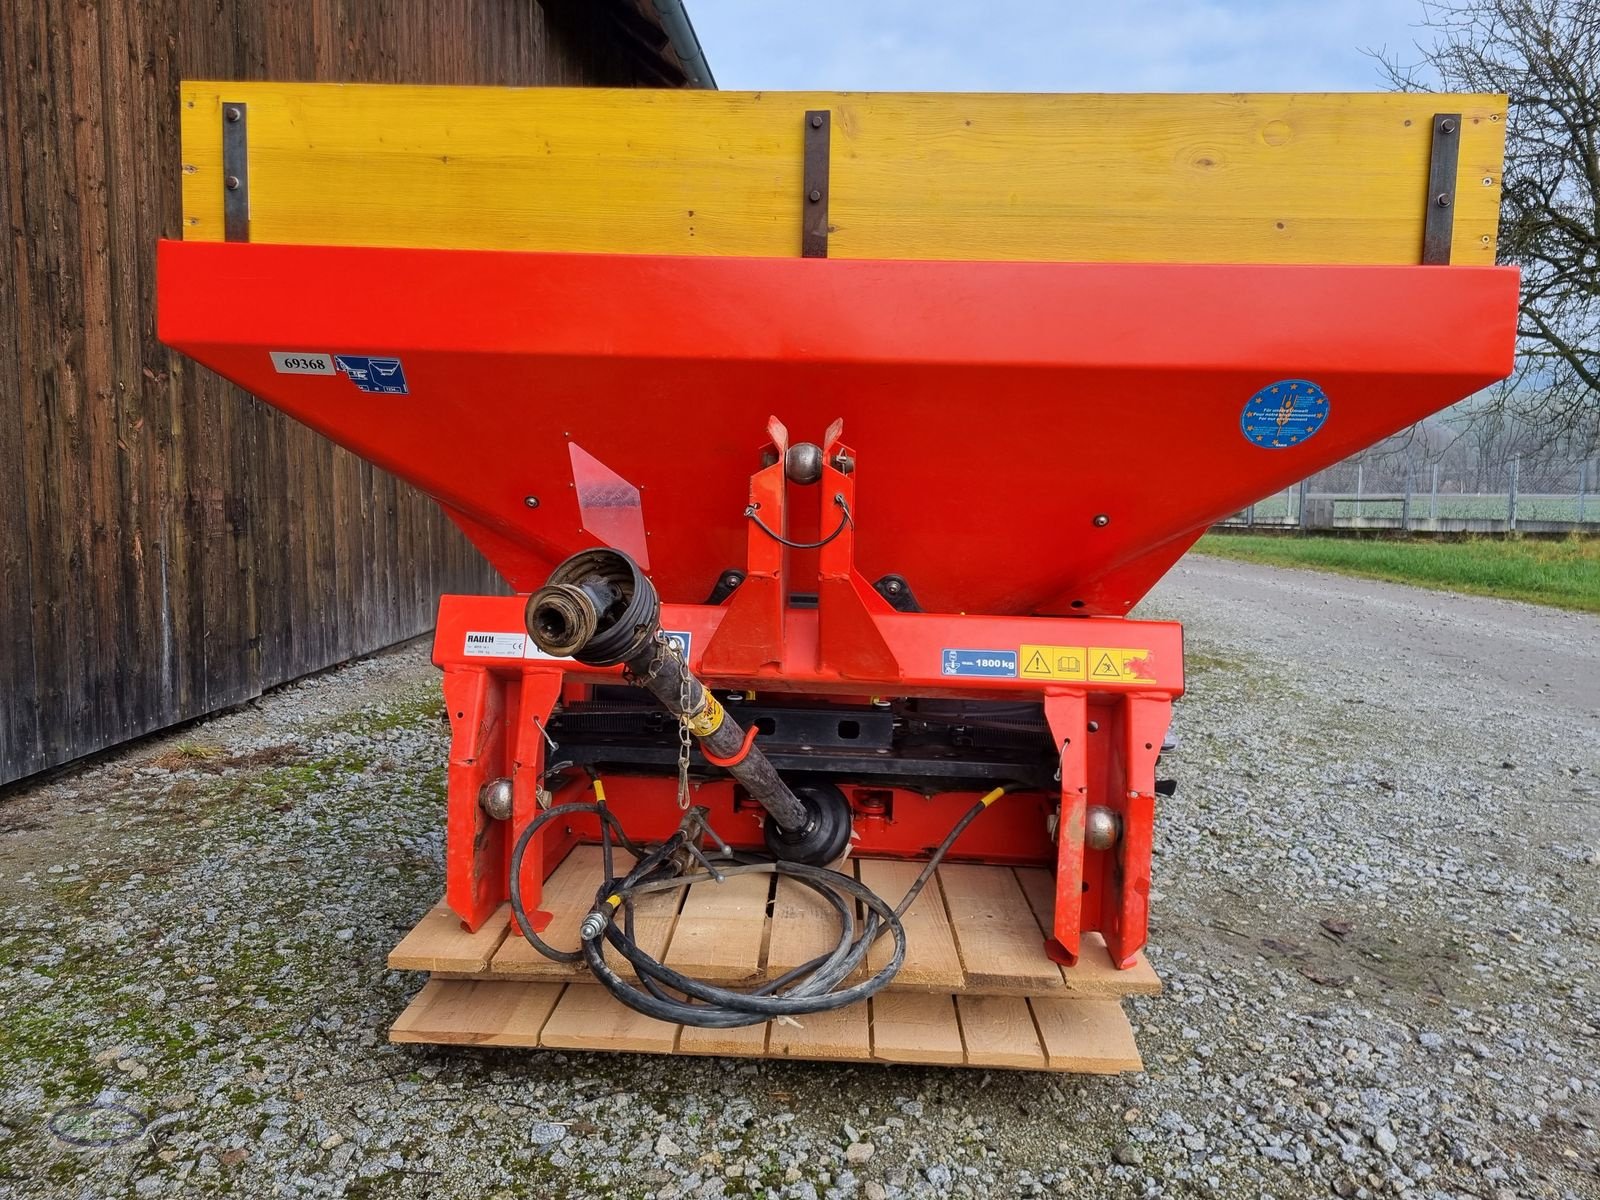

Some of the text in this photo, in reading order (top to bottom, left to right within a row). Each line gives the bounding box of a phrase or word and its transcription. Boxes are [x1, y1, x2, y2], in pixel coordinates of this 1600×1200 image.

[284, 358, 326, 370] 69368
[467, 635, 494, 643] RAUCH
[976, 659, 1001, 668] 1800
[1001, 659, 1015, 670] kg
